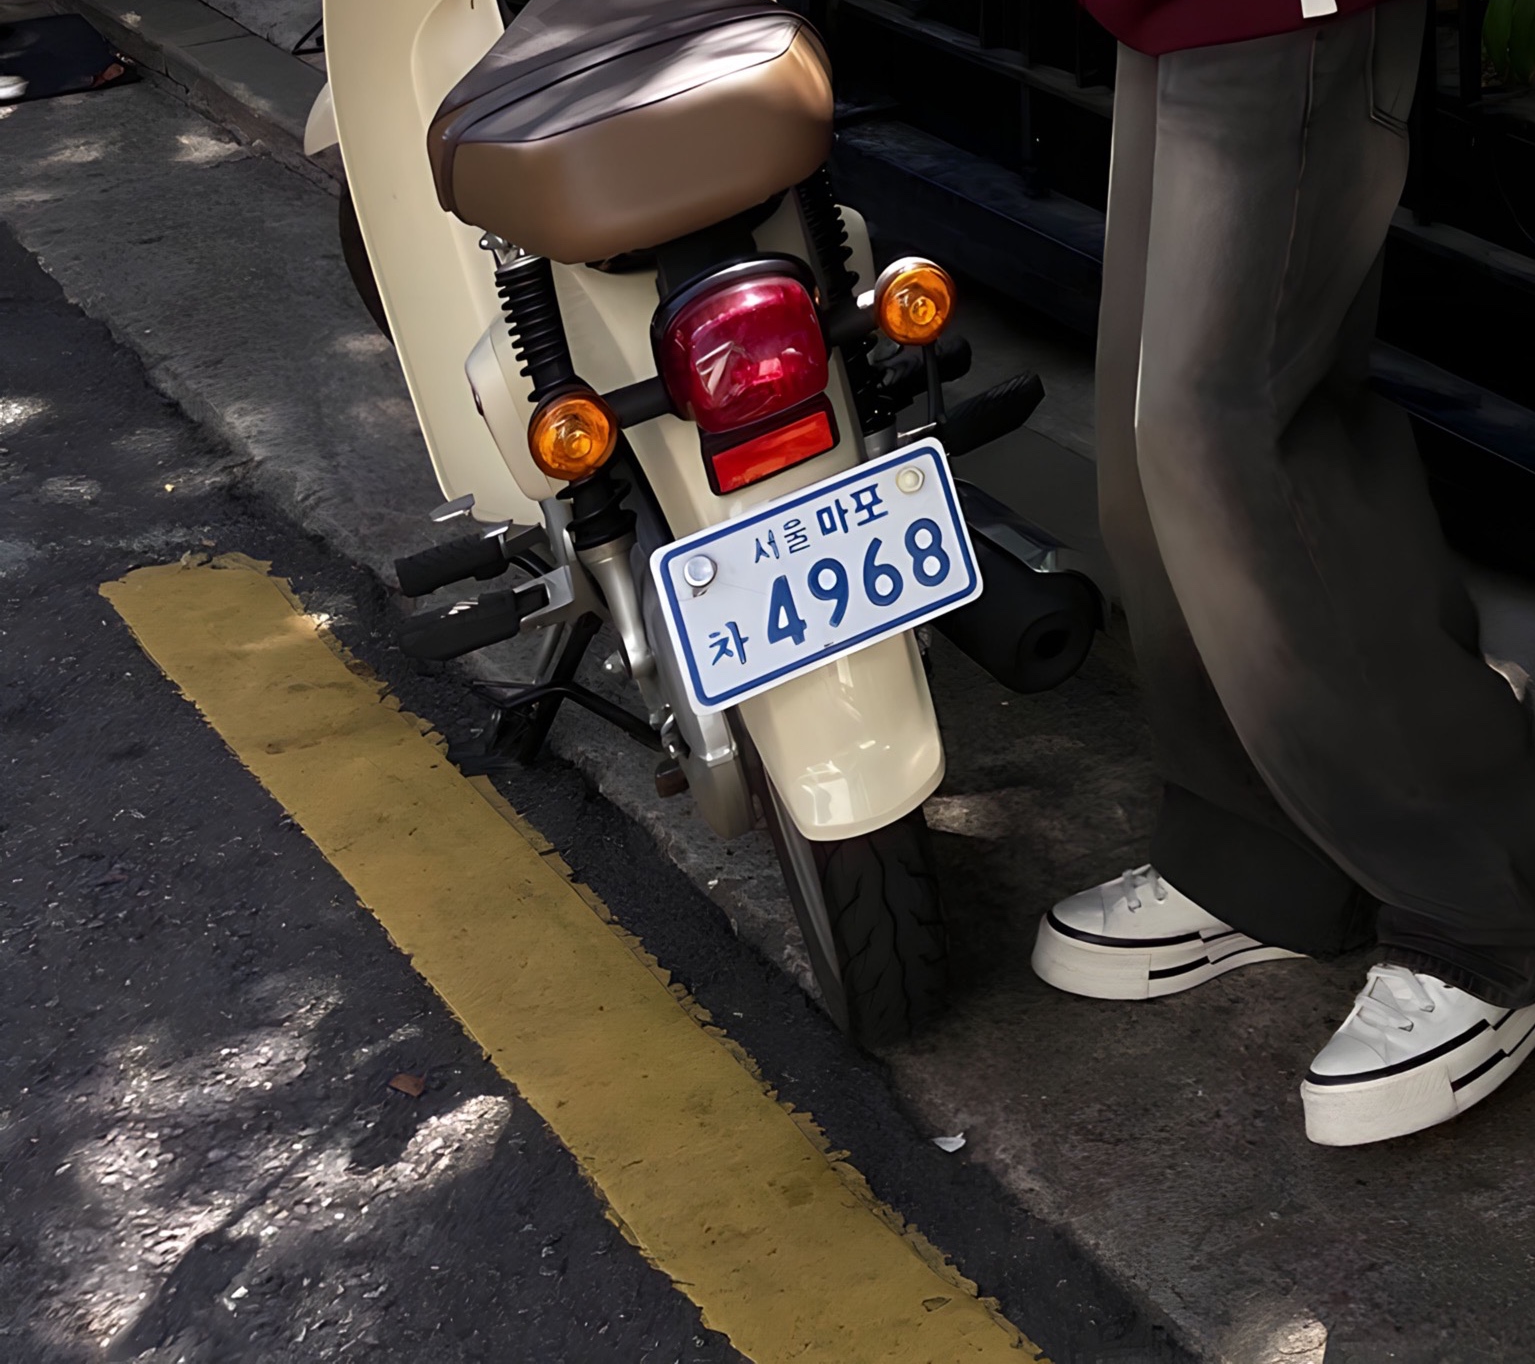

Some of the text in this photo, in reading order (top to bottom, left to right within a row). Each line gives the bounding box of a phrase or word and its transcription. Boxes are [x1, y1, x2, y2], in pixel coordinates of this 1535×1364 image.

[755, 483, 888, 563] 서울 마포
[709, 518, 951, 666] 차 4968
